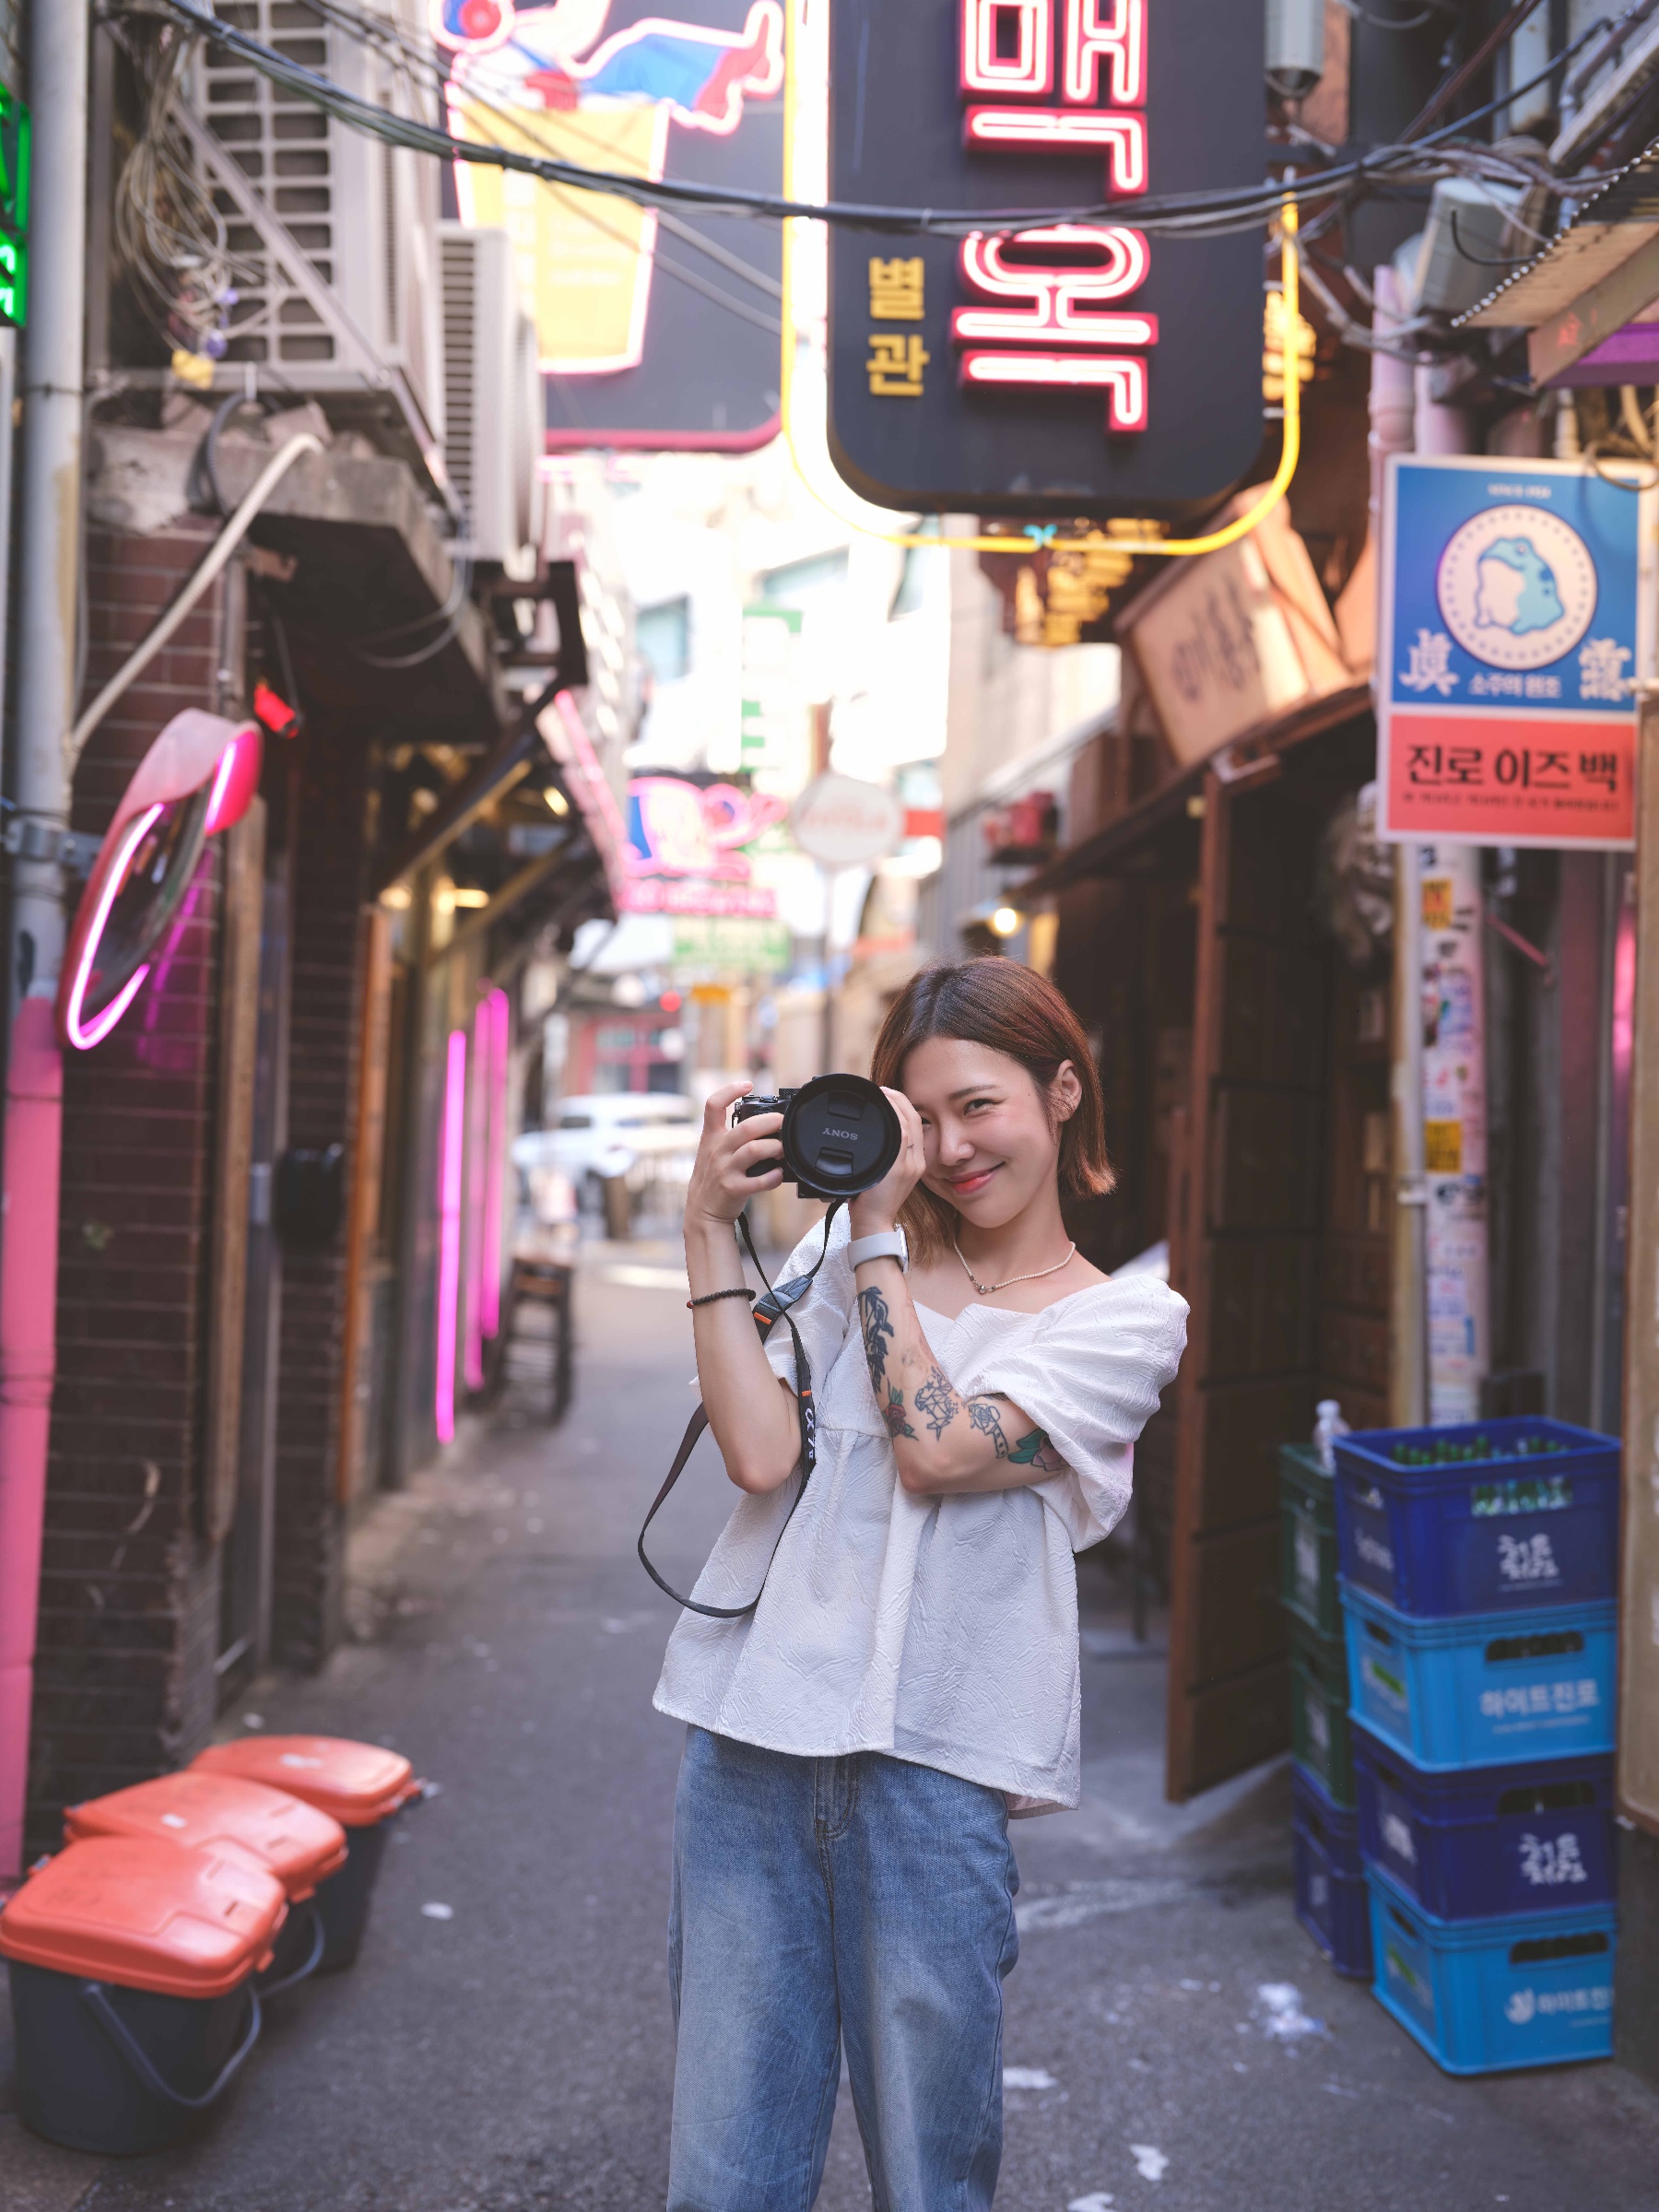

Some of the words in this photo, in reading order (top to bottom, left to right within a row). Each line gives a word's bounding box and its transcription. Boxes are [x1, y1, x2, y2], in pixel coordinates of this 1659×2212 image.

[868, 256, 931, 397] 별관
[1407, 746, 1483, 786] 진로
[1494, 747, 1571, 790] 이즈
[1579, 752, 1618, 793] 백
[822, 1127, 858, 1141] SONY
[1479, 1679, 1599, 1719] 하이트진로
